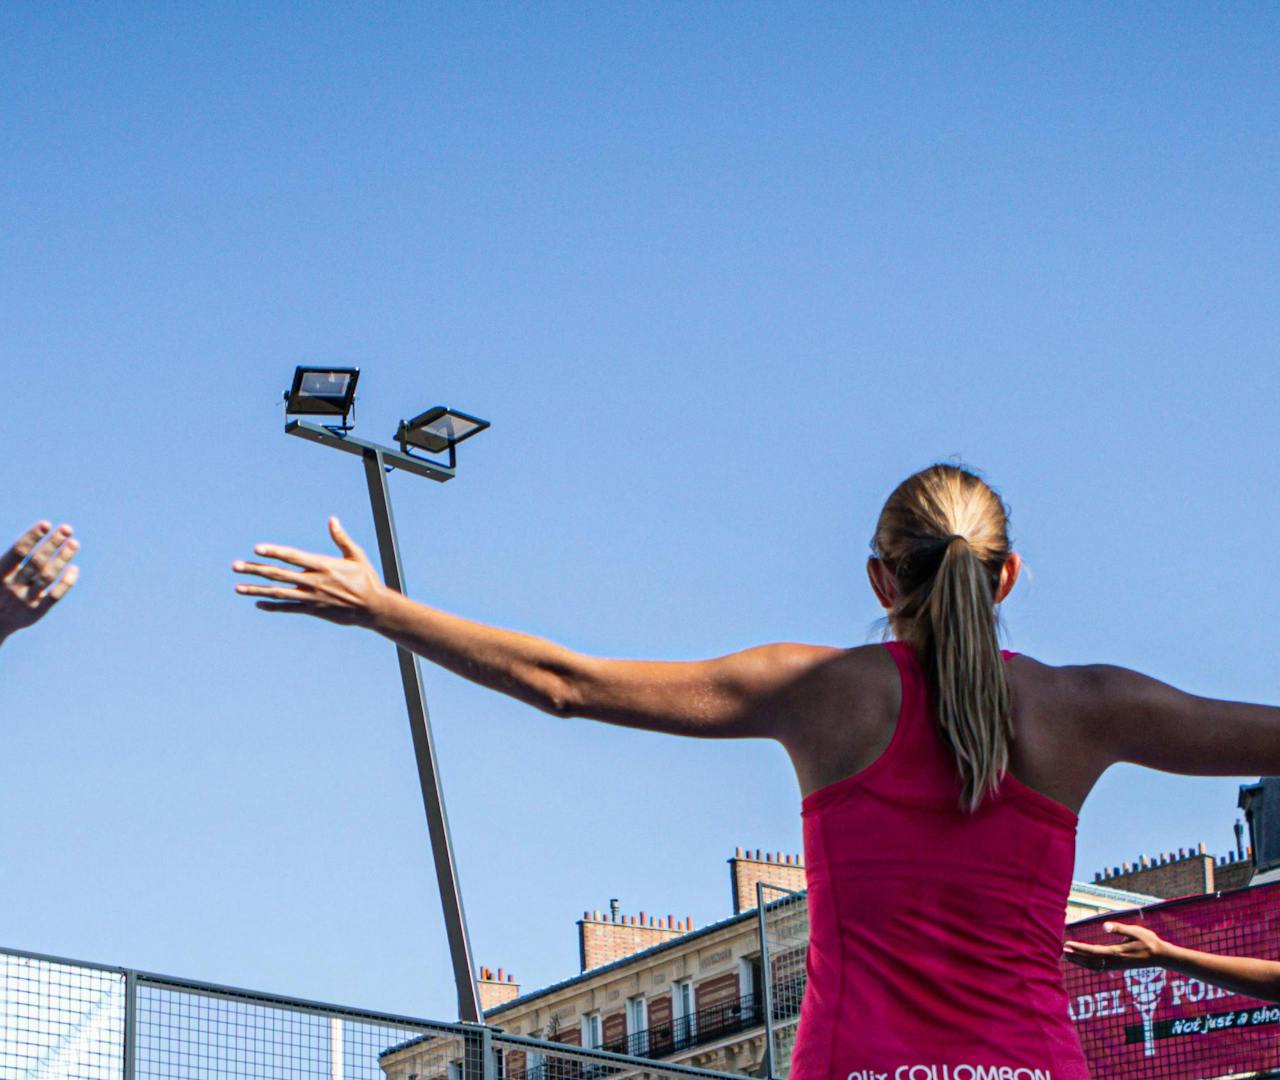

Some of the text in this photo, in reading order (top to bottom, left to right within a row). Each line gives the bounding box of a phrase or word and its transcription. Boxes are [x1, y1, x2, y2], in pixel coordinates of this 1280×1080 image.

[1171, 1017, 1202, 1034] Not
[1200, 1012, 1235, 1034] just
[1237, 1012, 1248, 1025] a
